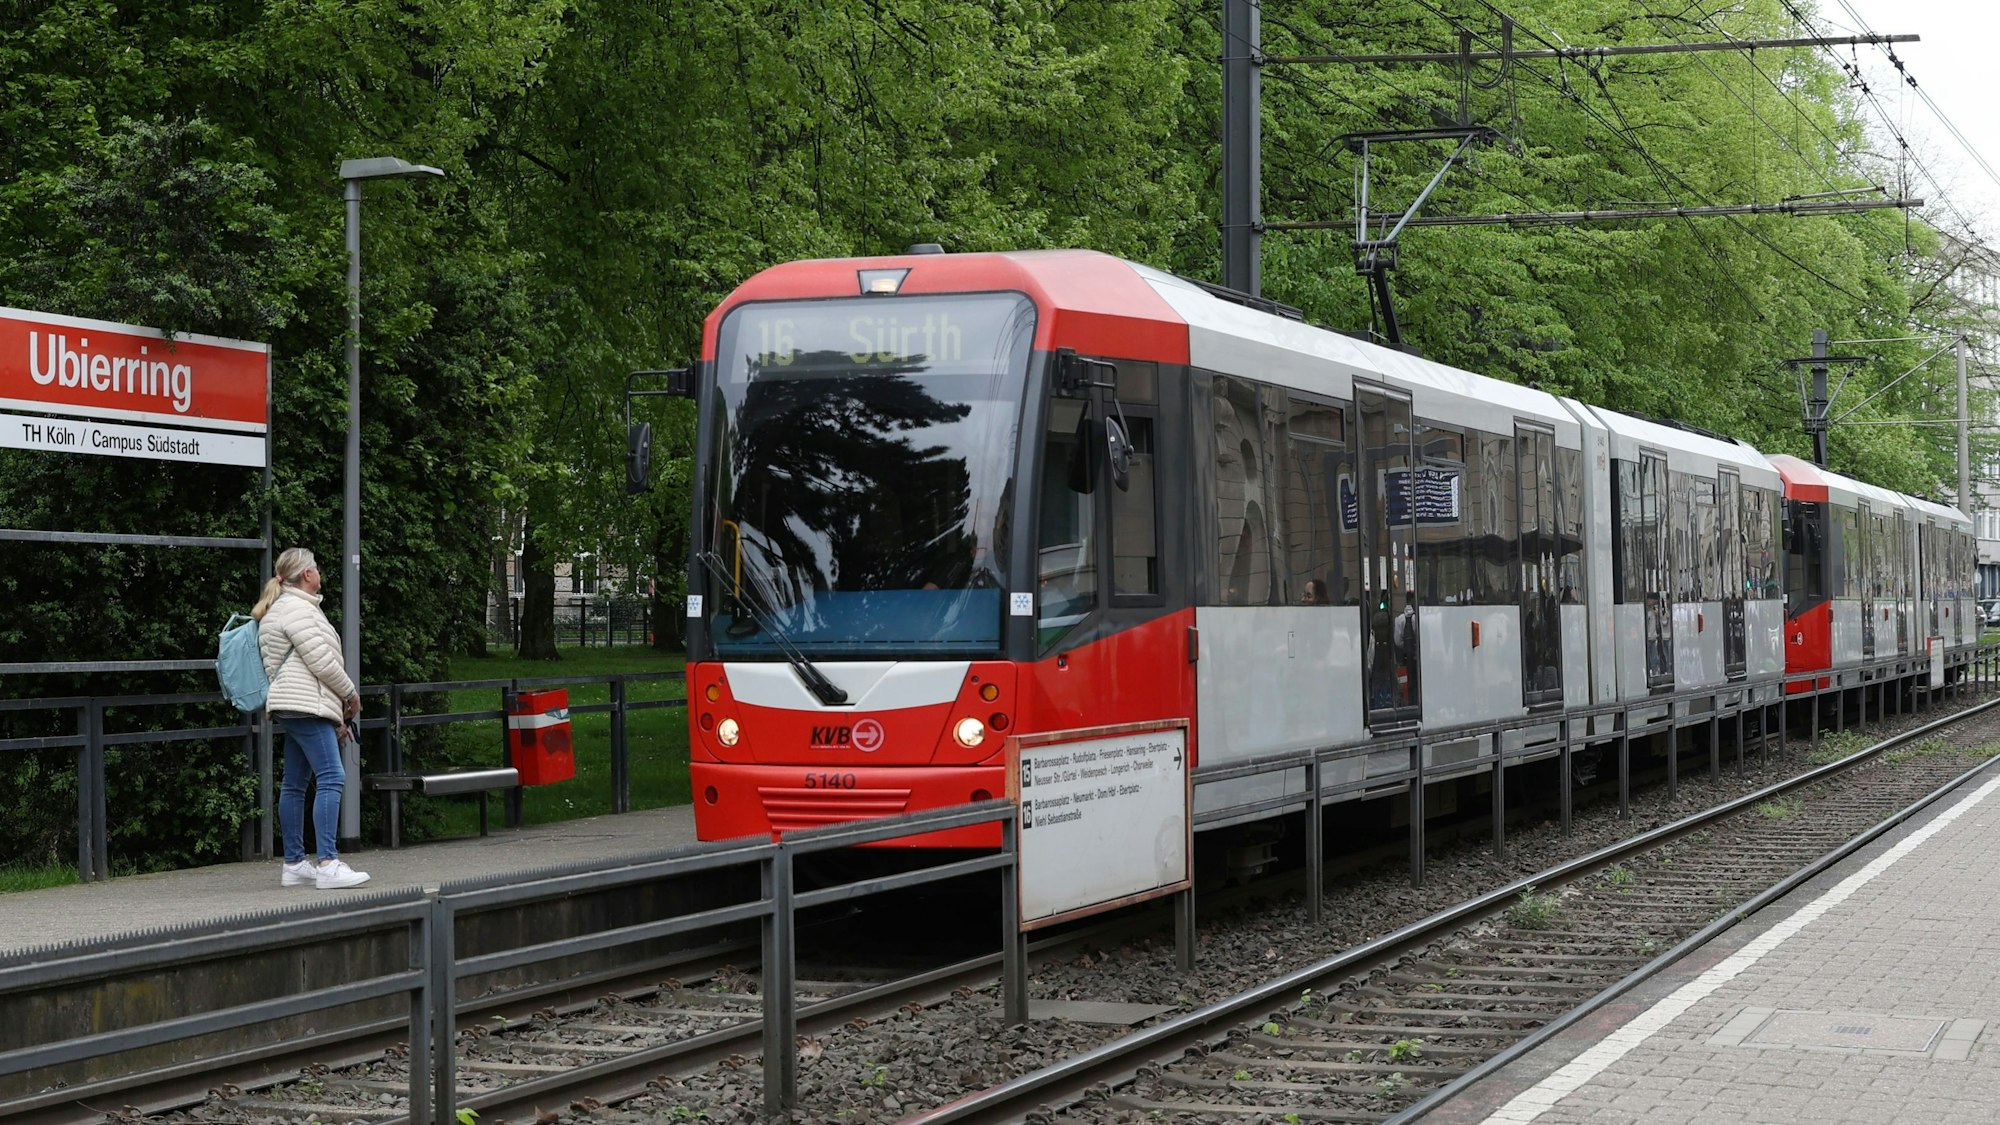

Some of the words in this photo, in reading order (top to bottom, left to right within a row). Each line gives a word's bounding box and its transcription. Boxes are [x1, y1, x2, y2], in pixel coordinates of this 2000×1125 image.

[758, 318, 794, 366] 16
[849, 314, 961, 363] Sürth
[29, 331, 192, 413] Ubierring
[22, 423, 42, 443] TH
[47, 425, 75, 446] Köln
[92, 429, 143, 453] Campus
[147, 434, 200, 456] Südstadt
[811, 726, 851, 745] KVB
[1034, 755, 1069, 769] Barbarossaplatz
[1073, 752, 1096, 764] Rudolfplatz
[1099, 747, 1123, 760] Friesenplatz
[1149, 741, 1167, 754] Ebertplatz
[805, 773, 856, 789] 5140
[1034, 775, 1052, 786] Neusser
[1035, 795, 1070, 810] Barbarossaplatz
[1073, 790, 1094, 803] Neumarkt
[1119, 783, 1139, 796] Ebertplatz
[1035, 813, 1047, 827] Niehl
[1047, 809, 1082, 825] Sebastianstraße
